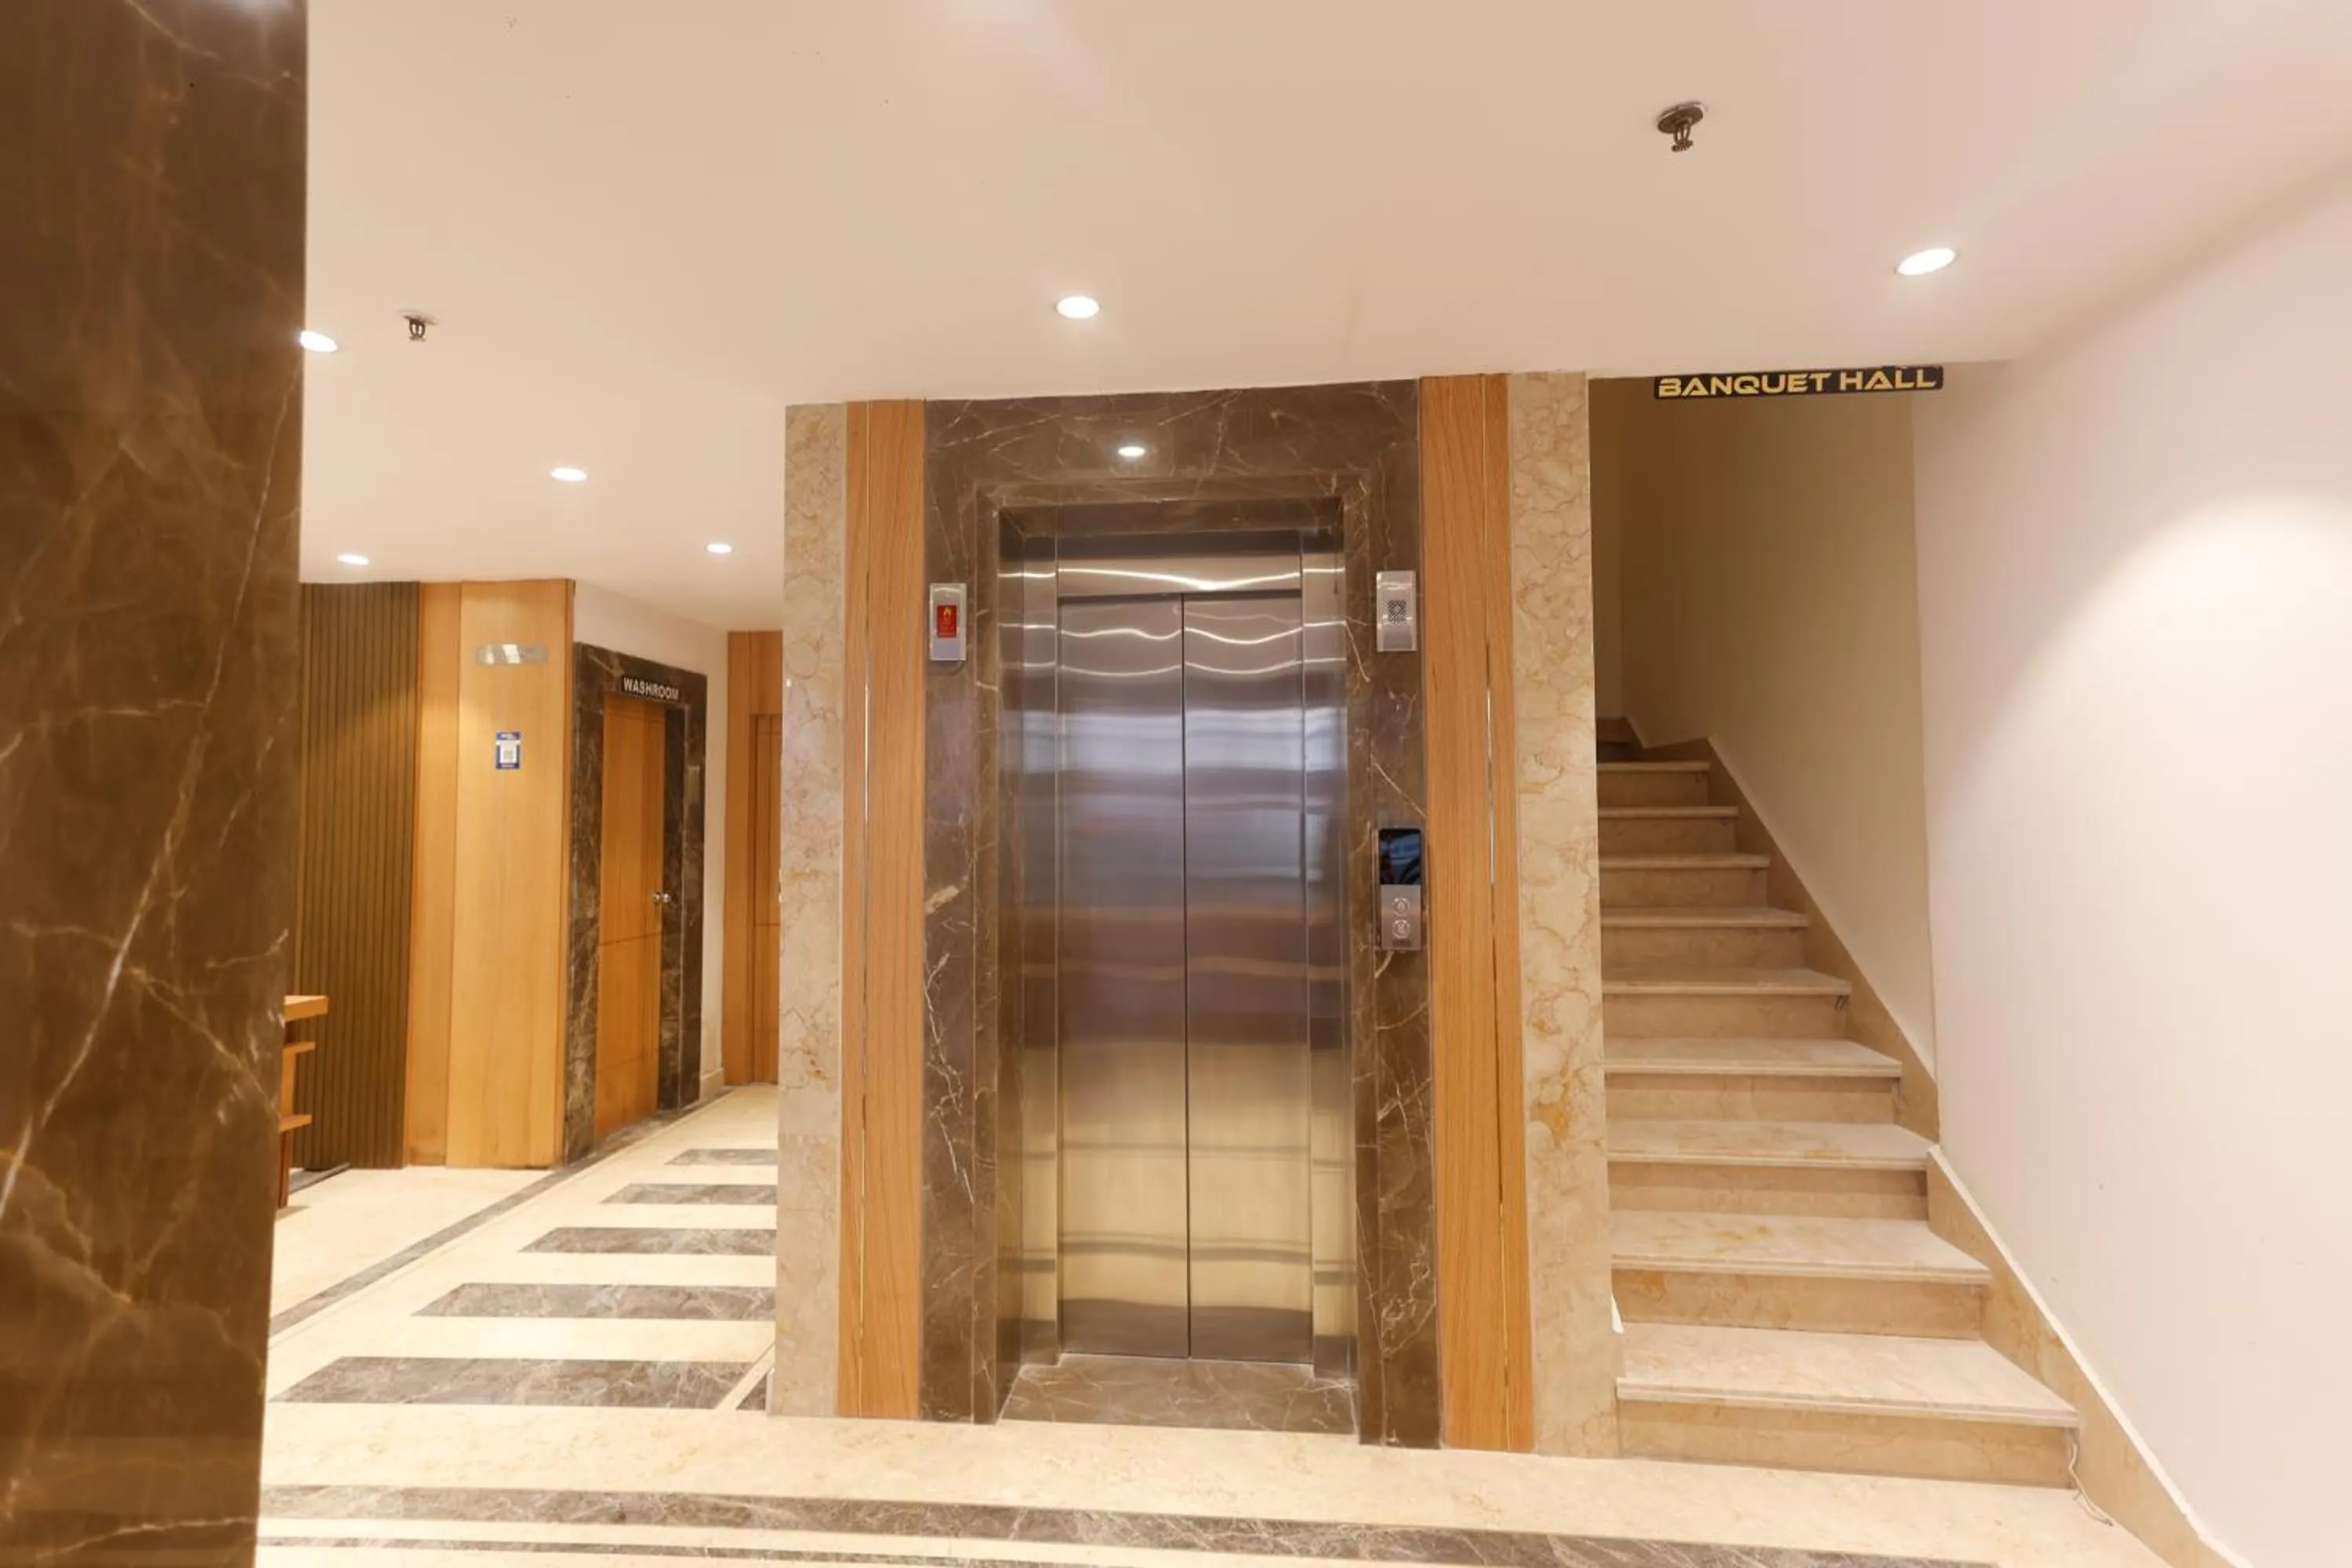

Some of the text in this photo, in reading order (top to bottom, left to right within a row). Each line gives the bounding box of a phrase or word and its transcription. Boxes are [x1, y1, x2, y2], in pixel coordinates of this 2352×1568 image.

[1658, 369, 1936, 397] BANQUET HALL
[623, 677, 679, 700] WASHROOM
